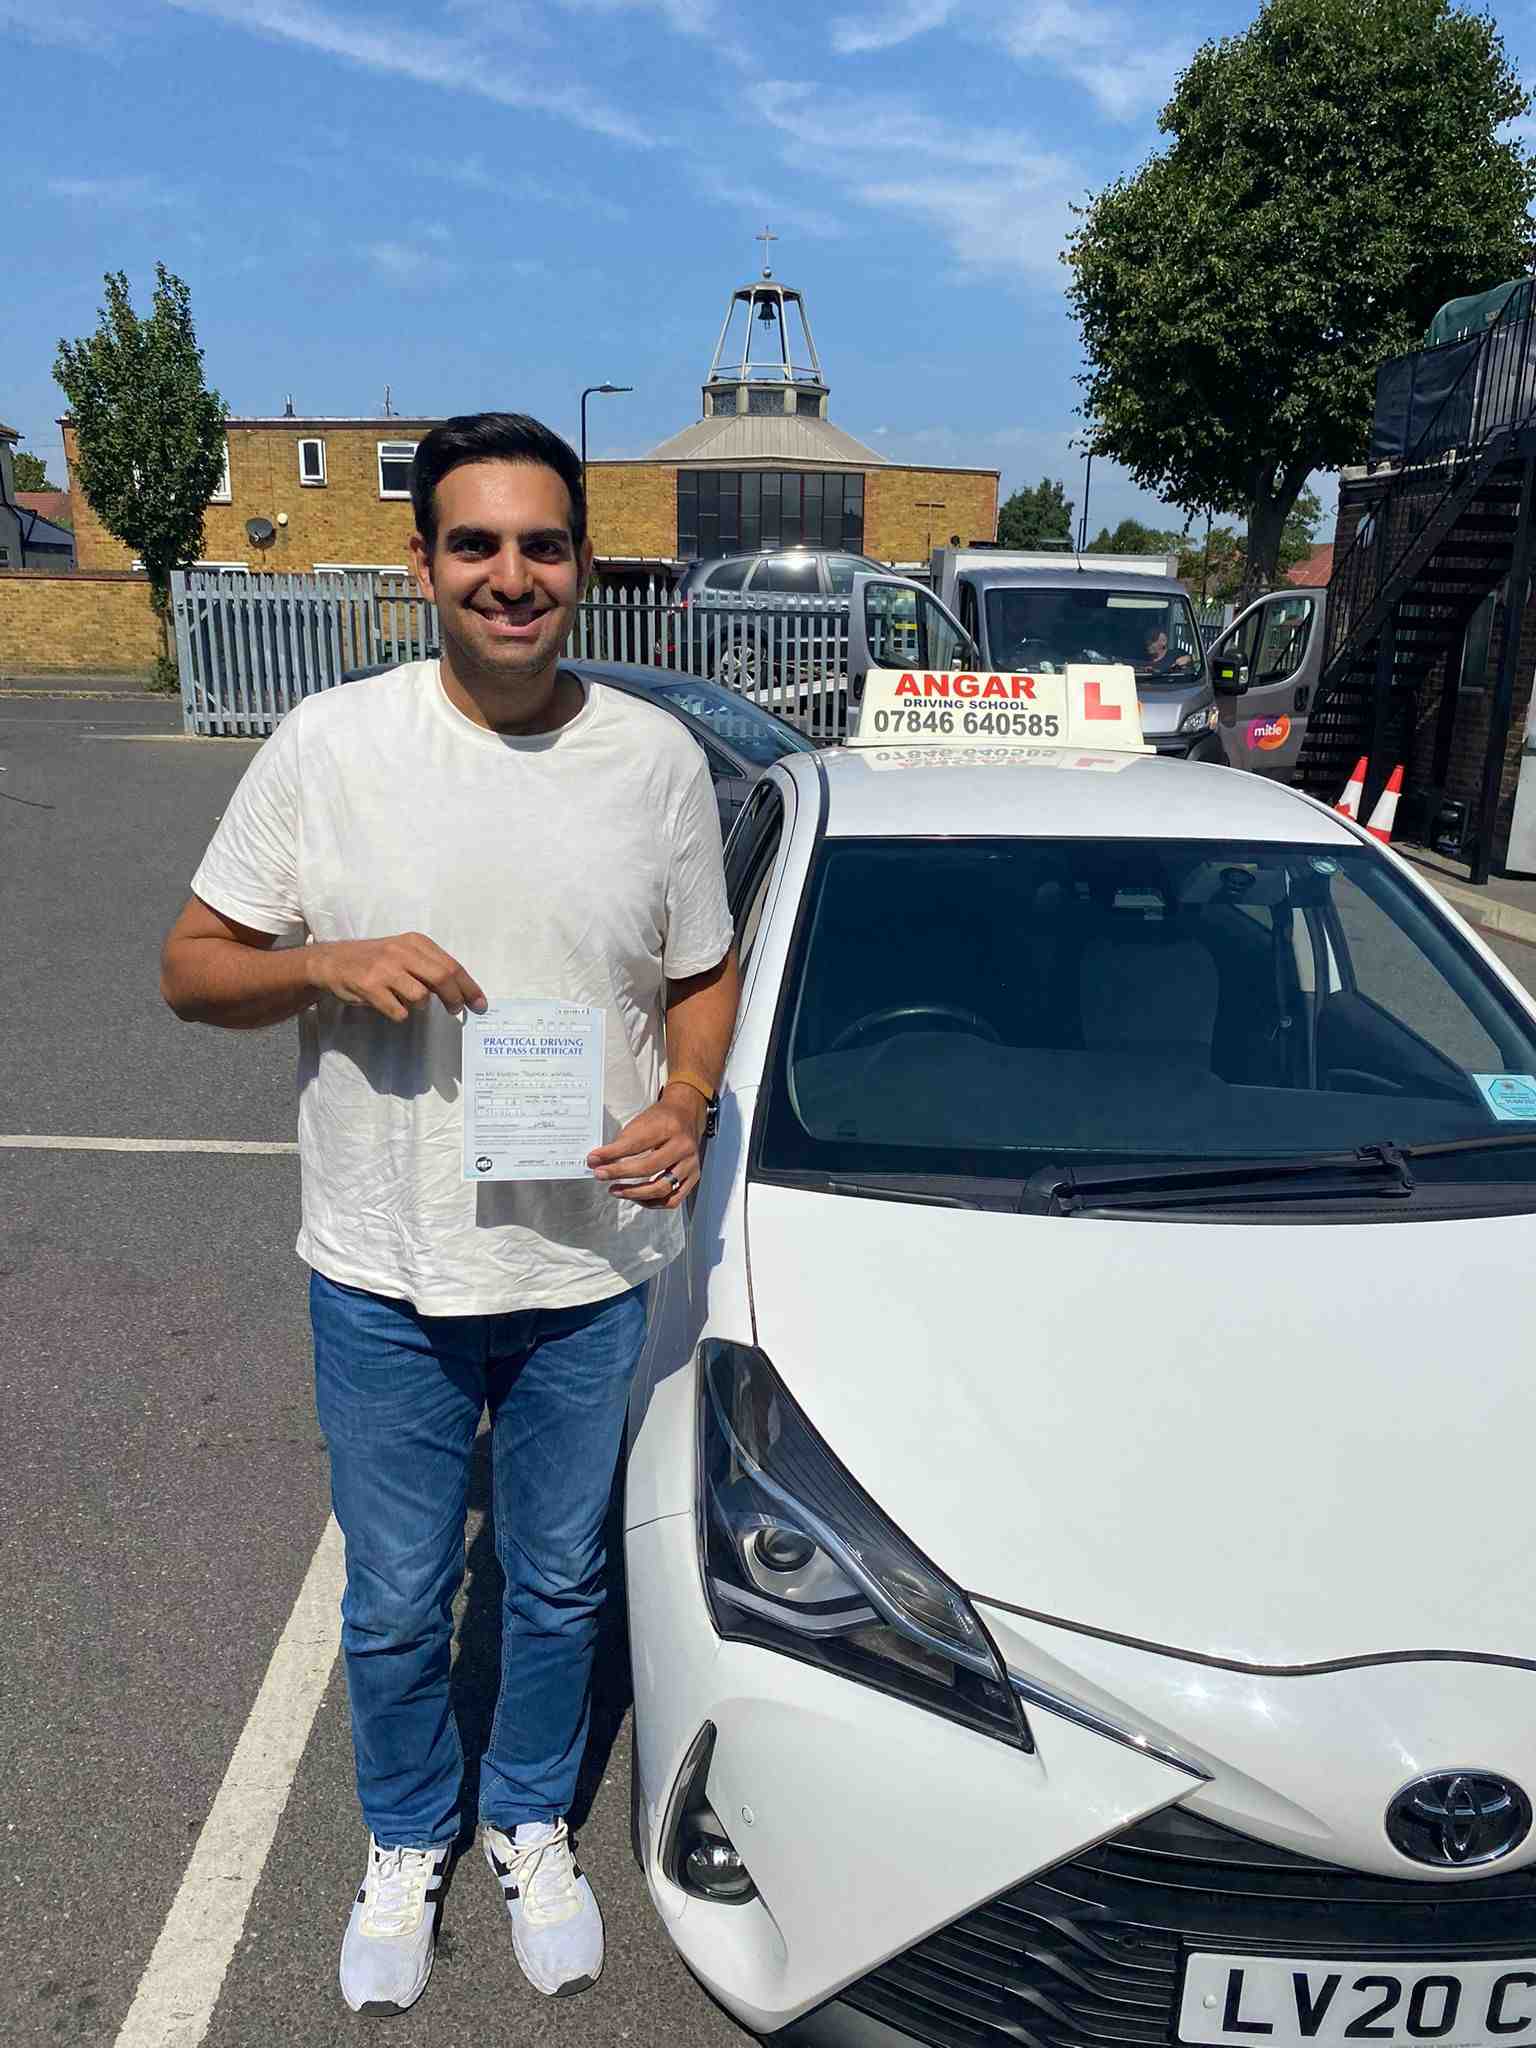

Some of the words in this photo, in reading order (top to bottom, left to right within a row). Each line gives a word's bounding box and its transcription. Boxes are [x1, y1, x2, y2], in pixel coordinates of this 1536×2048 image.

[894, 673, 1037, 699] ANGAR
[903, 698, 964, 709] DRIVING
[968, 700, 1028, 710] SCHOOL
[1083, 682, 1121, 720] L
[874, 710, 954, 734] 07846
[962, 712, 1060, 736] 640585
[1254, 724, 1283, 737] mitie
[483, 1037, 537, 1046] PRACTICAL
[540, 1037, 584, 1047] DRIVING
[484, 1047, 505, 1055] TEST
[506, 1047, 528, 1055] PASS
[529, 1047, 584, 1056] CERTIFICATE
[1222, 1968, 1463, 2039] LV20
